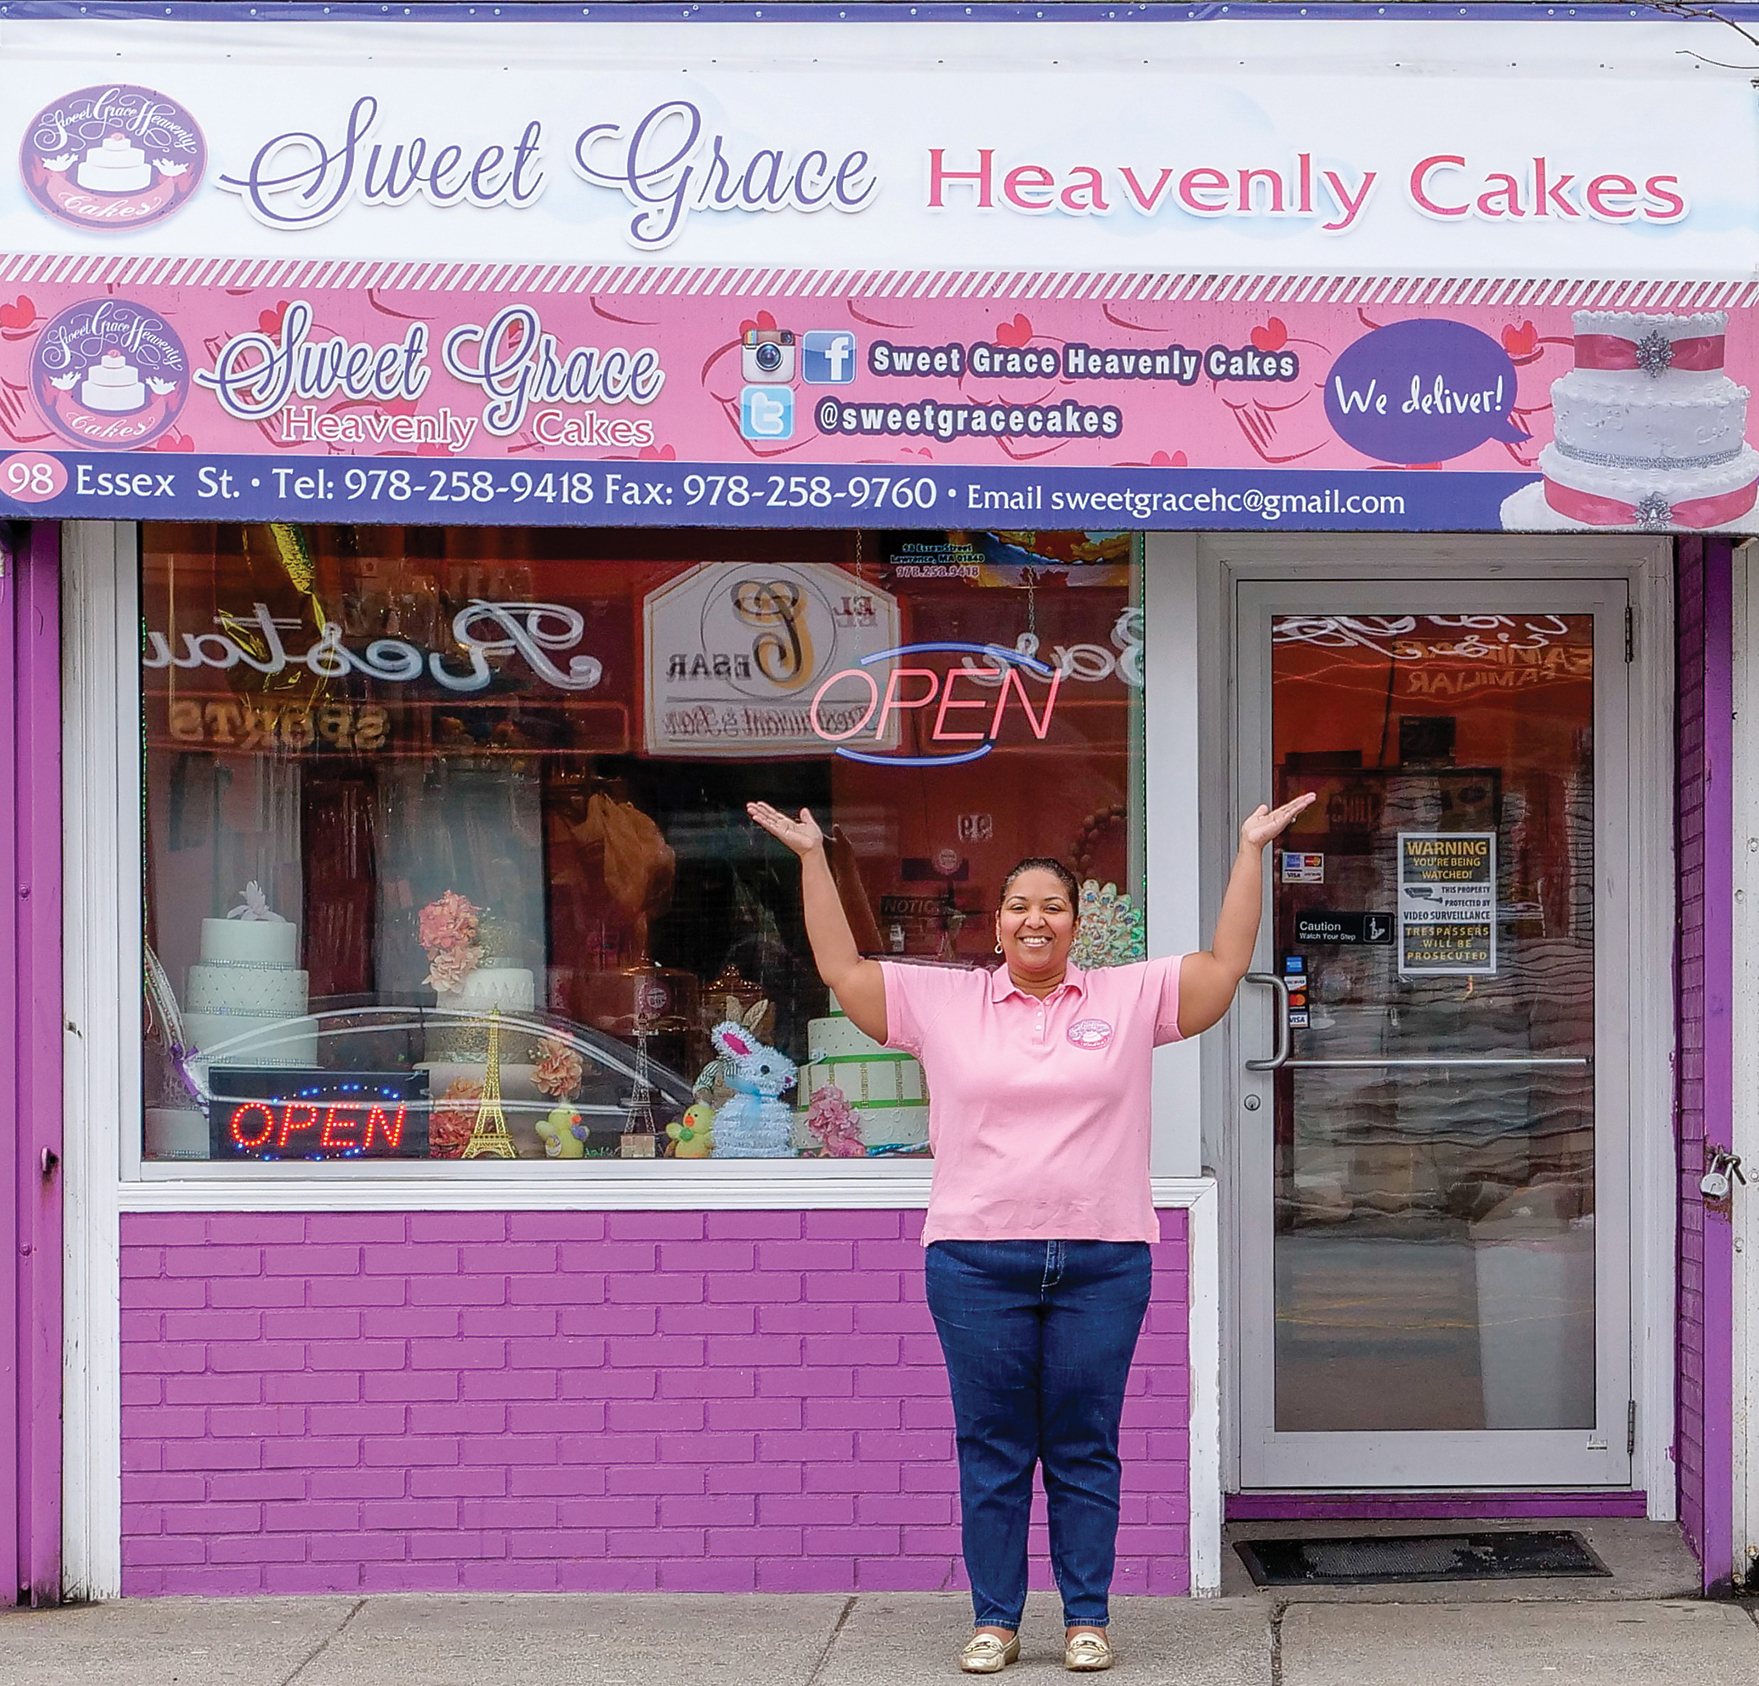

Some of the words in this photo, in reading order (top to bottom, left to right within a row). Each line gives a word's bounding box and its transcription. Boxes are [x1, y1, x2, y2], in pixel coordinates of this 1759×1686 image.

[34, 102, 93, 152] Sweet
[69, 87, 140, 140] Grace
[118, 93, 198, 155] Heavenly
[218, 94, 544, 224] Sweet
[575, 100, 879, 244] Grace
[928, 147, 1377, 232] Heavenly
[1411, 155, 1687, 221] Cakes
[59, 191, 163, 219] Cakes
[42, 317, 92, 370] Sweet
[70, 301, 131, 358] Grace
[113, 307, 184, 371] Heavenly
[197, 305, 428, 416] Sweet
[446, 307, 664, 432] Grace
[872, 345, 961, 374] Sweet
[971, 346, 1056, 375] Grace
[1067, 346, 1198, 381] Heavenly
[1209, 348, 1295, 378] Cakes
[1334, 374, 1387, 416] We
[1401, 373, 1504, 415] deliver!
[66, 411, 156, 439] Cakes
[281, 405, 476, 449] Heavenly
[532, 409, 654, 446] Cakes
[818, 401, 1119, 436] @sweetgracecakes
[8, 466, 55, 496] 98
[75, 464, 177, 498] Essex
[197, 466, 241, 499] St.
[271, 467, 334, 501] Tel:
[344, 468, 593, 504] 978-258-9418
[604, 474, 673, 506] Fax:
[683, 474, 938, 510] 978-258-9760
[967, 484, 1042, 513] Email
[1050, 485, 1406, 521] sweetgracehc@gmail.com
[809, 668, 1063, 741] OPEN
[1406, 841, 1488, 857] WARNING
[1413, 857, 1450, 868] YOU'RE
[1450, 857, 1482, 868] BEING
[1421, 869, 1473, 880] WATCHED!
[1441, 886, 1457, 895] THIS
[1457, 886, 1491, 895] PROPERTY
[1444, 899, 1481, 908] PROTECTED
[1480, 899, 1491, 908] BY
[884, 899, 946, 914] NOTIC
[1403, 910, 1429, 921] VIDEO
[1430, 910, 1491, 921] SURVEILLANCE
[1299, 920, 1342, 933] Caution
[1299, 932, 1321, 942] Watch
[1321, 932, 1339, 942] Your
[1339, 933, 1357, 943] Step
[1405, 926, 1490, 938] TRESPASSERS
[1406, 951, 1488, 962] PROSECUTED
[1422, 939, 1453, 949] WILL
[1456, 939, 1473, 949] BE
[230, 1102, 407, 1148] OPEN
